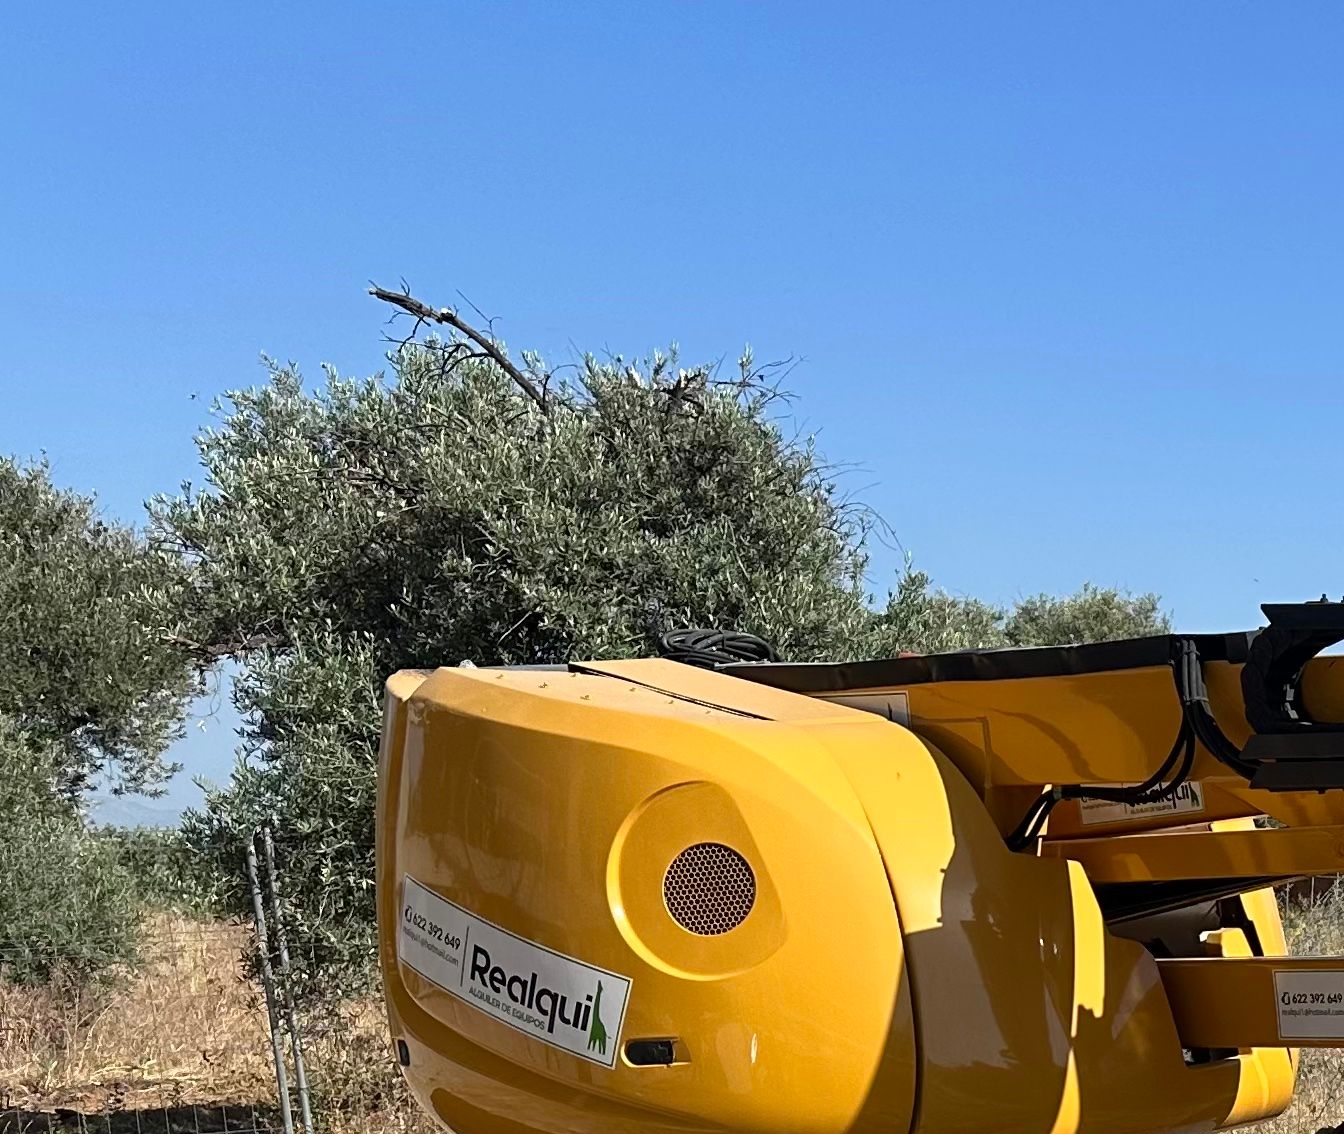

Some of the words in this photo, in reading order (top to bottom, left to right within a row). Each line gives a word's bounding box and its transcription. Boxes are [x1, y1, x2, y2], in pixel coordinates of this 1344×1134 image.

[412, 912, 427, 932] 622
[427, 921, 443, 941] 392
[444, 933, 461, 950] 649
[468, 986, 501, 1010] ALQUILER
[501, 1002, 512, 1015] DE
[512, 1007, 546, 1030] EQUIPOS
[469, 943, 593, 1034] Realqui
[1292, 992, 1308, 1004] 622
[1309, 992, 1326, 1004] 392
[1327, 992, 1343, 1004] 649
